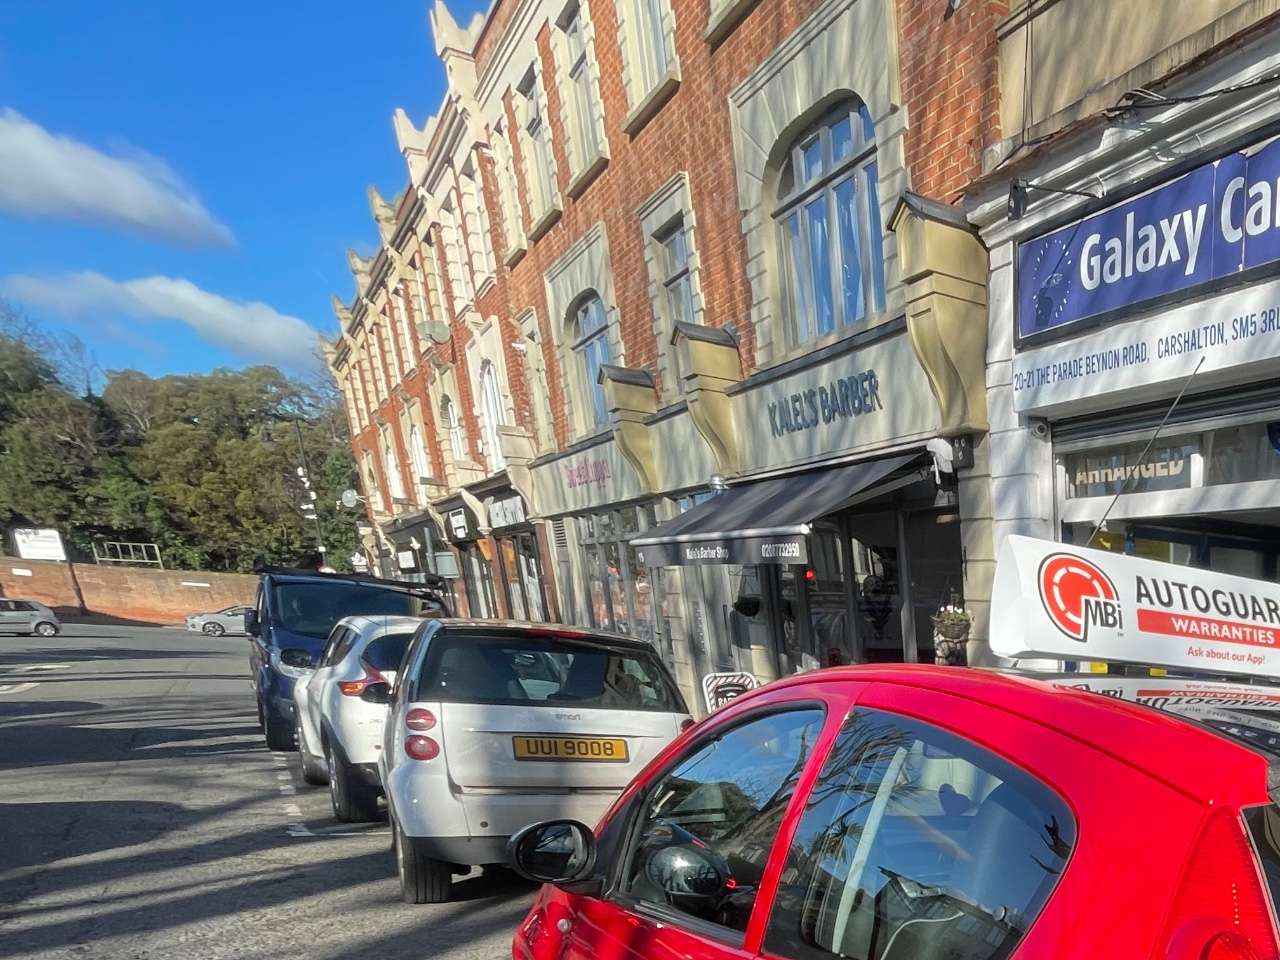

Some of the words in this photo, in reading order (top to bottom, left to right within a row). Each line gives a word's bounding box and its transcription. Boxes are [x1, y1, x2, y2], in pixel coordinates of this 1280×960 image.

[1079, 202, 1208, 291] Galaxy
[1014, 373, 1035, 391] 20-21
[1035, 366, 1051, 386] THE
[1052, 357, 1083, 382] PARADE
[1085, 351, 1120, 375] BEYNON
[1157, 323, 1228, 359] CARSHALTON,
[1231, 316, 1257, 340] SM5
[818, 369, 883, 424] BARBER
[1172, 617, 1276, 645] WARRANTIES
[1187, 646, 1203, 658] Ask
[1205, 648, 1230, 662] about
[1232, 653, 1245, 662] our
[1247, 652, 1266, 665] App!
[526, 739, 558, 756] UUI
[564, 740, 614, 757] 9008
